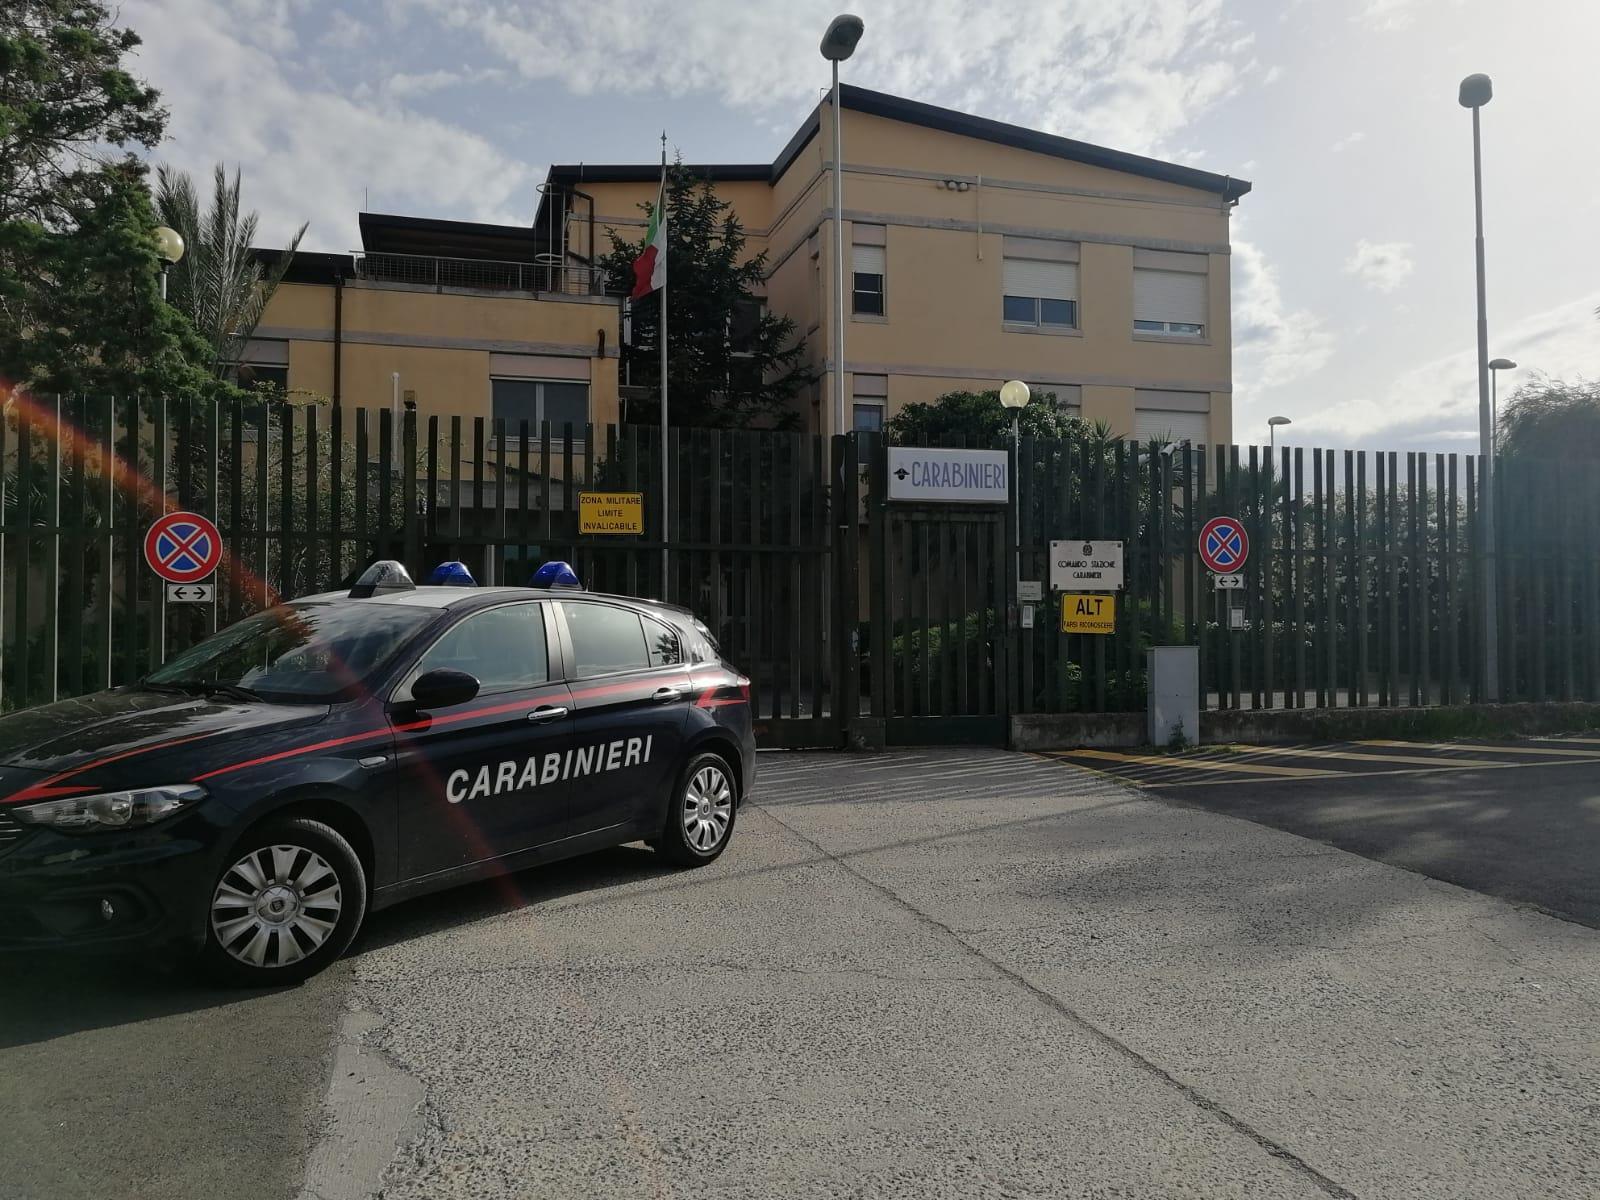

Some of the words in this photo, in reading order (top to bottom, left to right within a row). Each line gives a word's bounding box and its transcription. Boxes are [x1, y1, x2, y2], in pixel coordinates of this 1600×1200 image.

[911, 461, 1006, 489] CARABINIERI
[581, 496, 602, 504] ZONA
[606, 497, 641, 505] MILITARE
[597, 509, 624, 517] LIMITE
[583, 522, 637, 530] INVALICABILE
[1076, 598, 1103, 615] ALT
[446, 734, 653, 804] CARABINIERI
